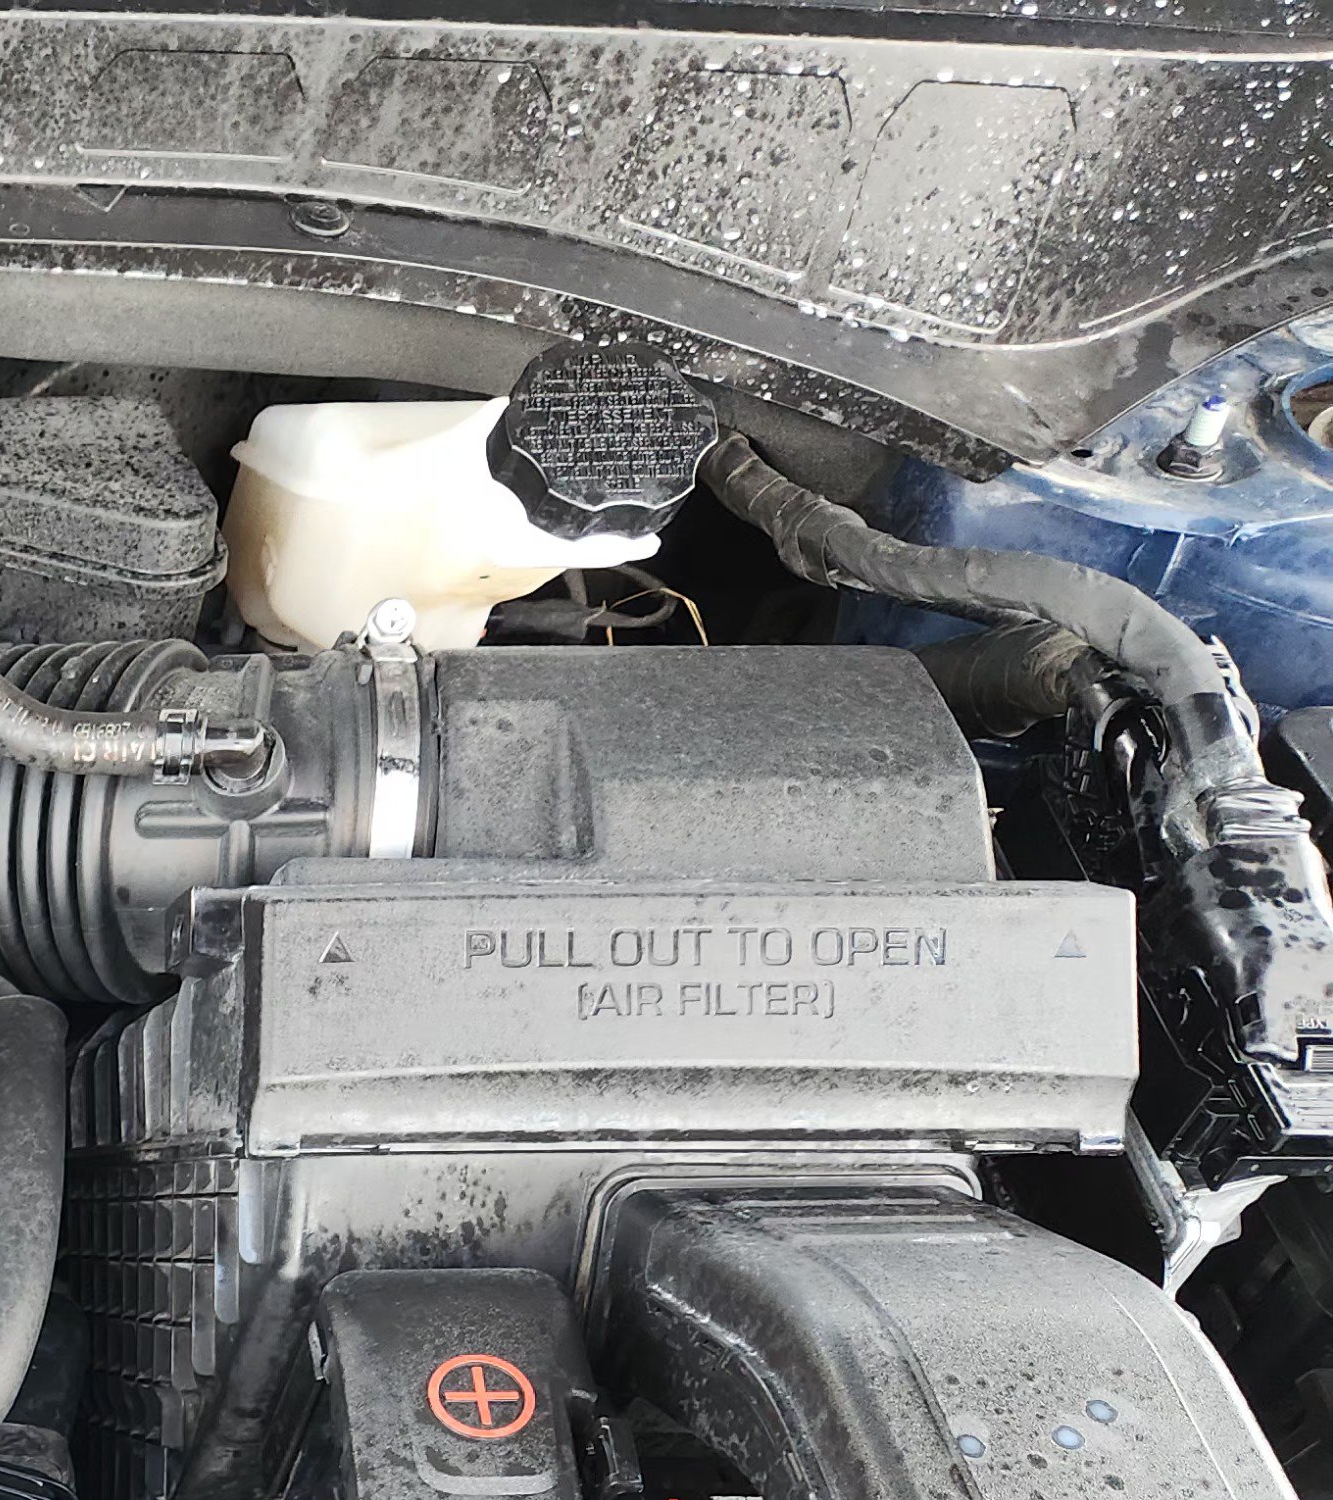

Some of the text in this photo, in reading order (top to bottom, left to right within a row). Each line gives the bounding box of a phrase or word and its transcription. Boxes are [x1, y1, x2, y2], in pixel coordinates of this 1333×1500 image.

[464, 927, 947, 969] PULL OUT TO OPEN
